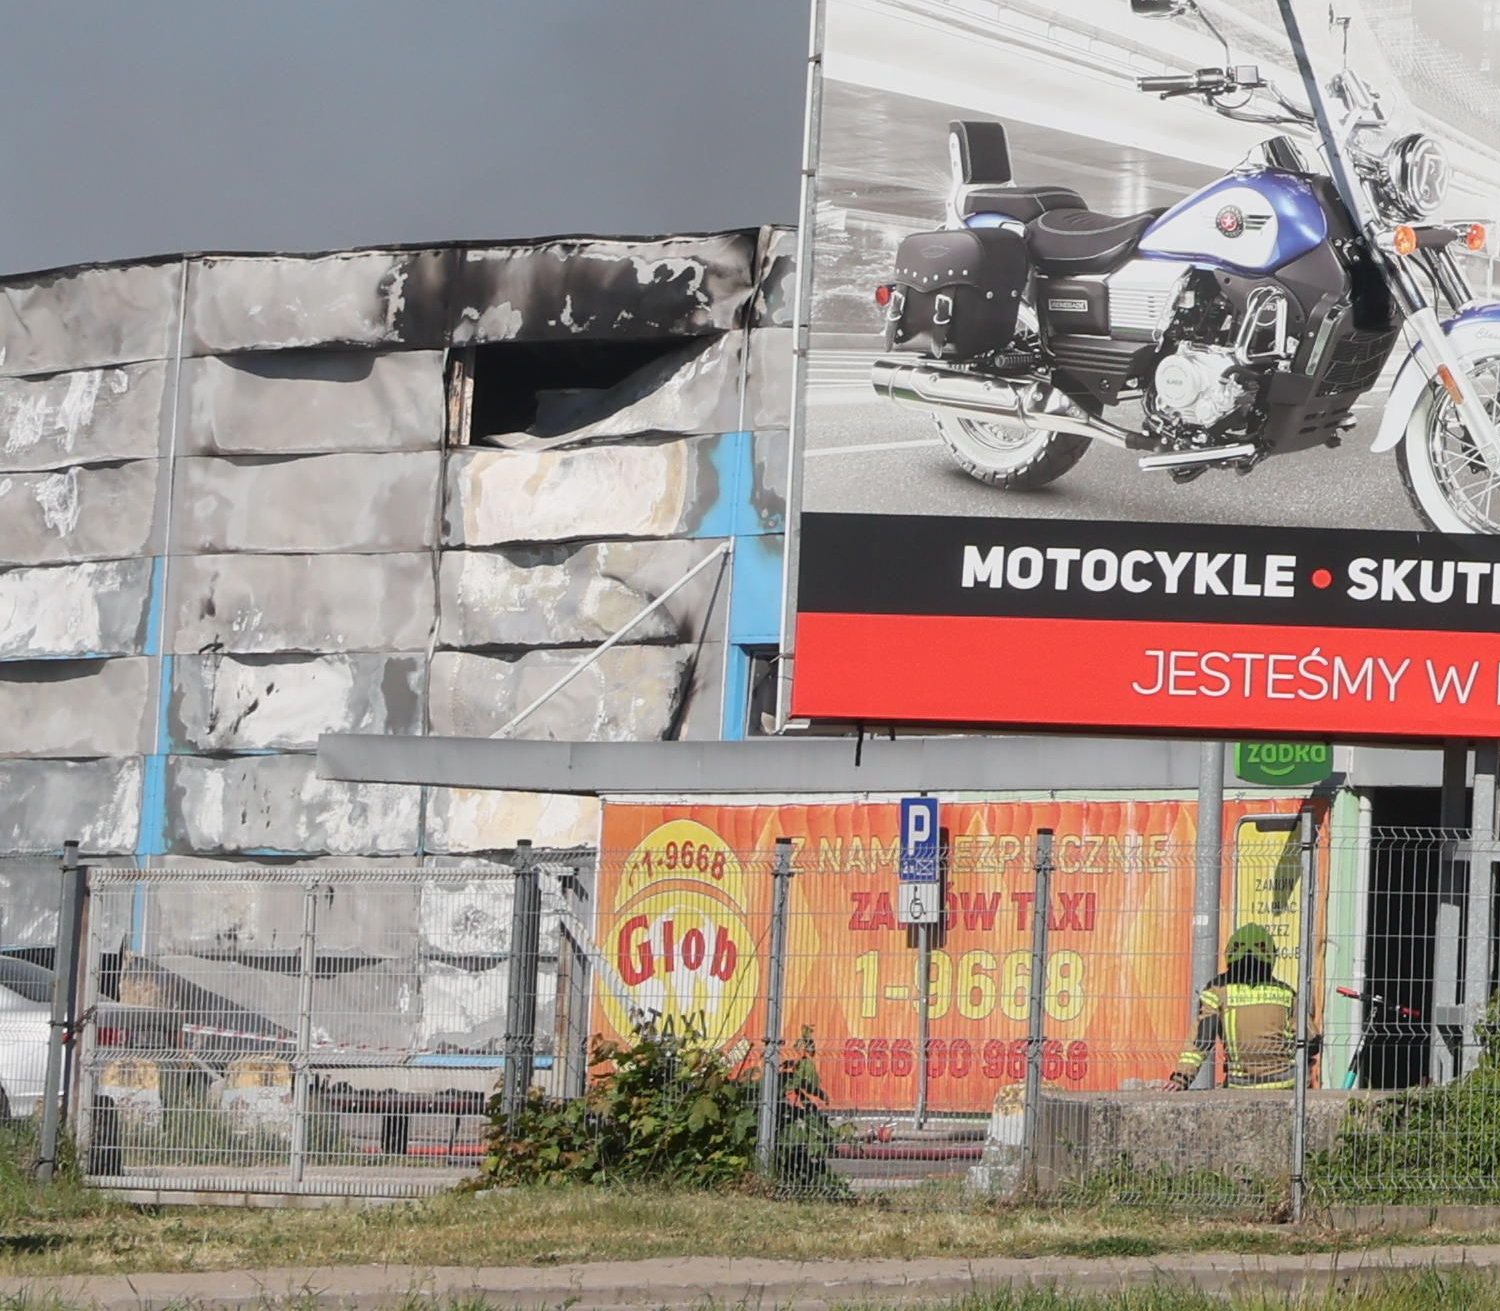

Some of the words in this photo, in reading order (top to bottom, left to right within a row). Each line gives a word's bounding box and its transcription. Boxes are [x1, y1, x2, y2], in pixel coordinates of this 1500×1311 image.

[961, 545, 1297, 597] MOTOCYKLE
[1131, 646, 1410, 703] JESTEŚMY
[1427, 661, 1479, 703] W
[908, 805, 930, 856] P
[618, 914, 738, 986] Glob
[855, 950, 1086, 1021] 1-9668
[844, 1038, 914, 1079] 666
[927, 1038, 972, 1079] 00
